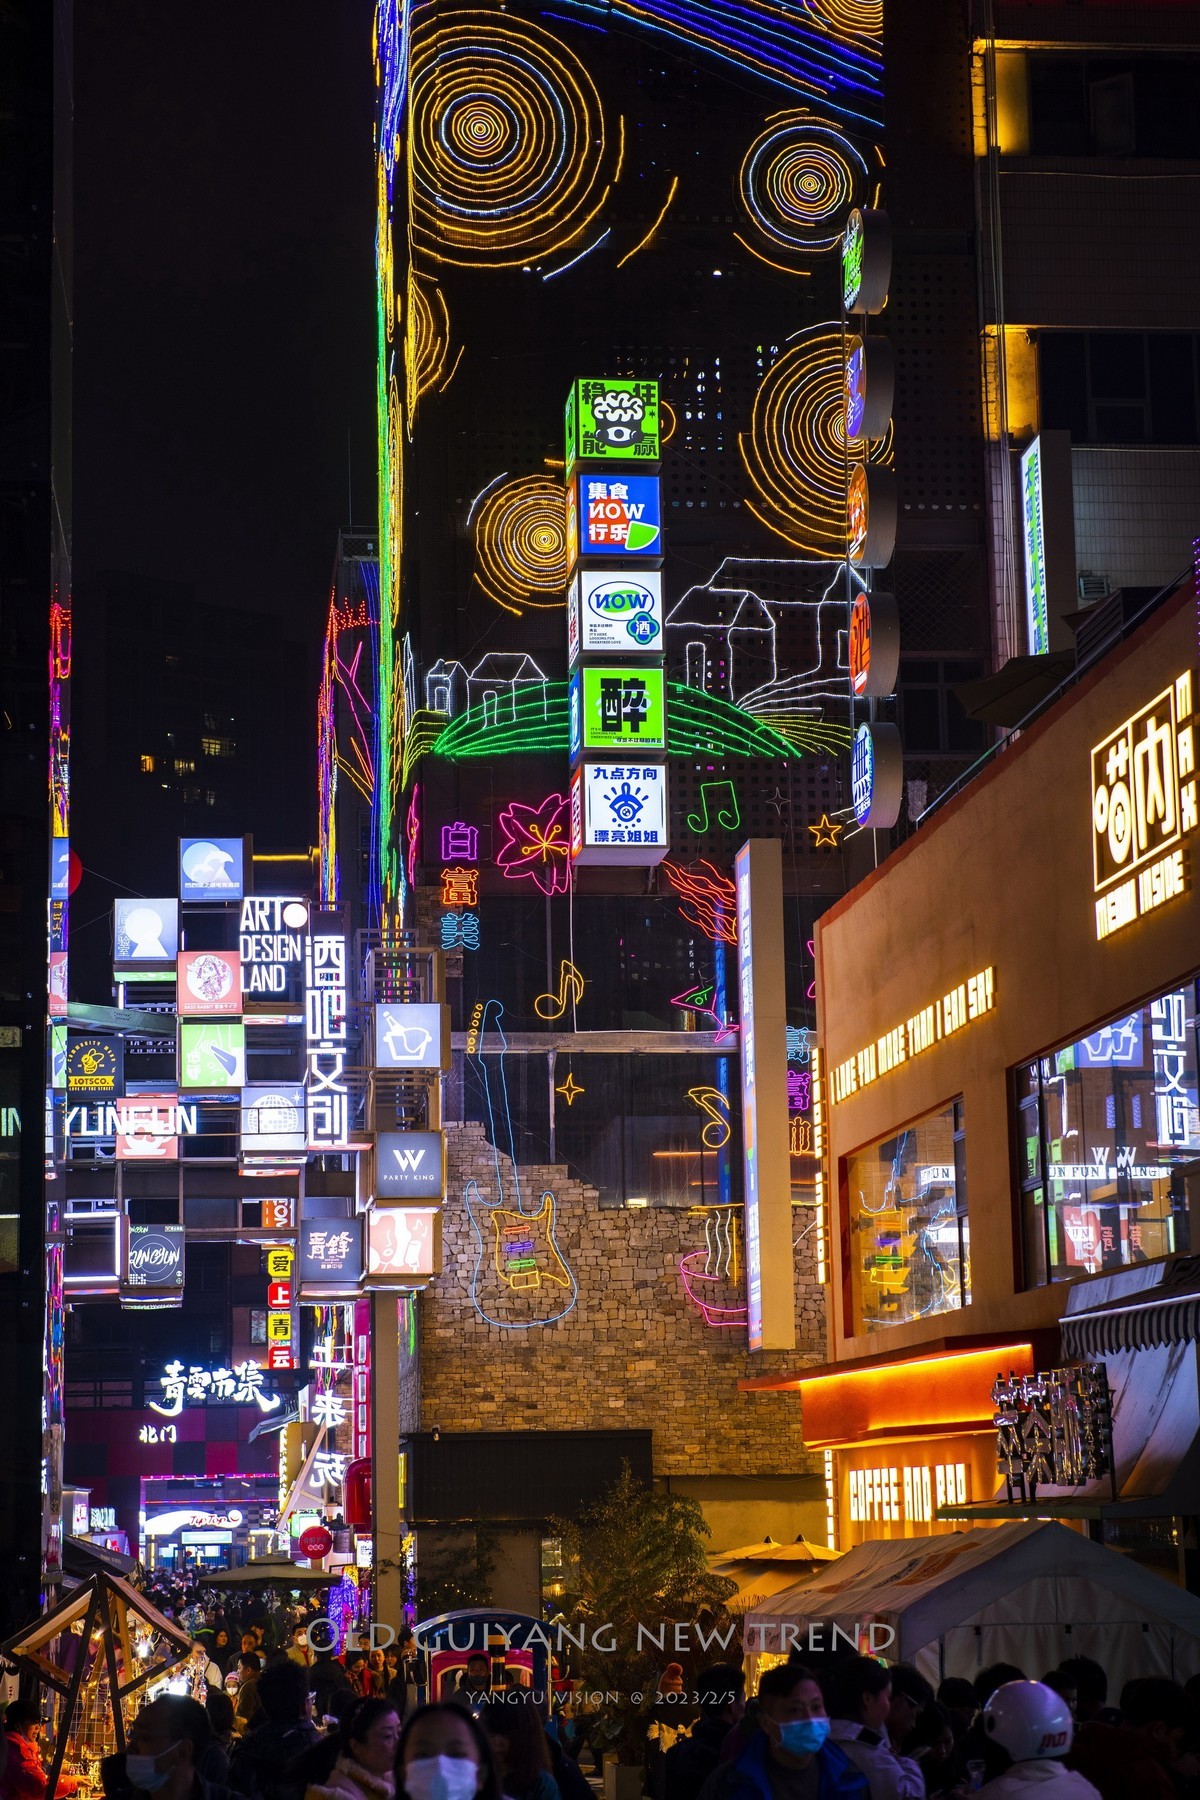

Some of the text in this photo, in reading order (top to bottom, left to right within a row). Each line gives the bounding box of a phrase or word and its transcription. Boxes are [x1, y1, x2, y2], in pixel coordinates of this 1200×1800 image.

[588, 482, 628, 500] 集食
[589, 523, 628, 542] 行乐
[636, 620, 650, 636] 酒
[600, 678, 647, 733] 醉
[594, 767, 658, 780] 九点方向
[594, 829, 659, 843] 漂亮姐姐
[441, 821, 480, 950] 白富美
[240, 898, 285, 931] ART
[239, 934, 302, 961] DESIGN
[240, 964, 286, 992] LAND
[877, 1024, 906, 1076] MORE
[906, 1005, 935, 1057] THAN
[943, 984, 968, 1036] CAN
[967, 966, 994, 1020] SAY
[305, 935, 348, 1146] 酒吧文创
[138, 1425, 178, 1443] 北门
[849, 1467, 900, 1521] COFFEE
[903, 1465, 932, 1522] AND
